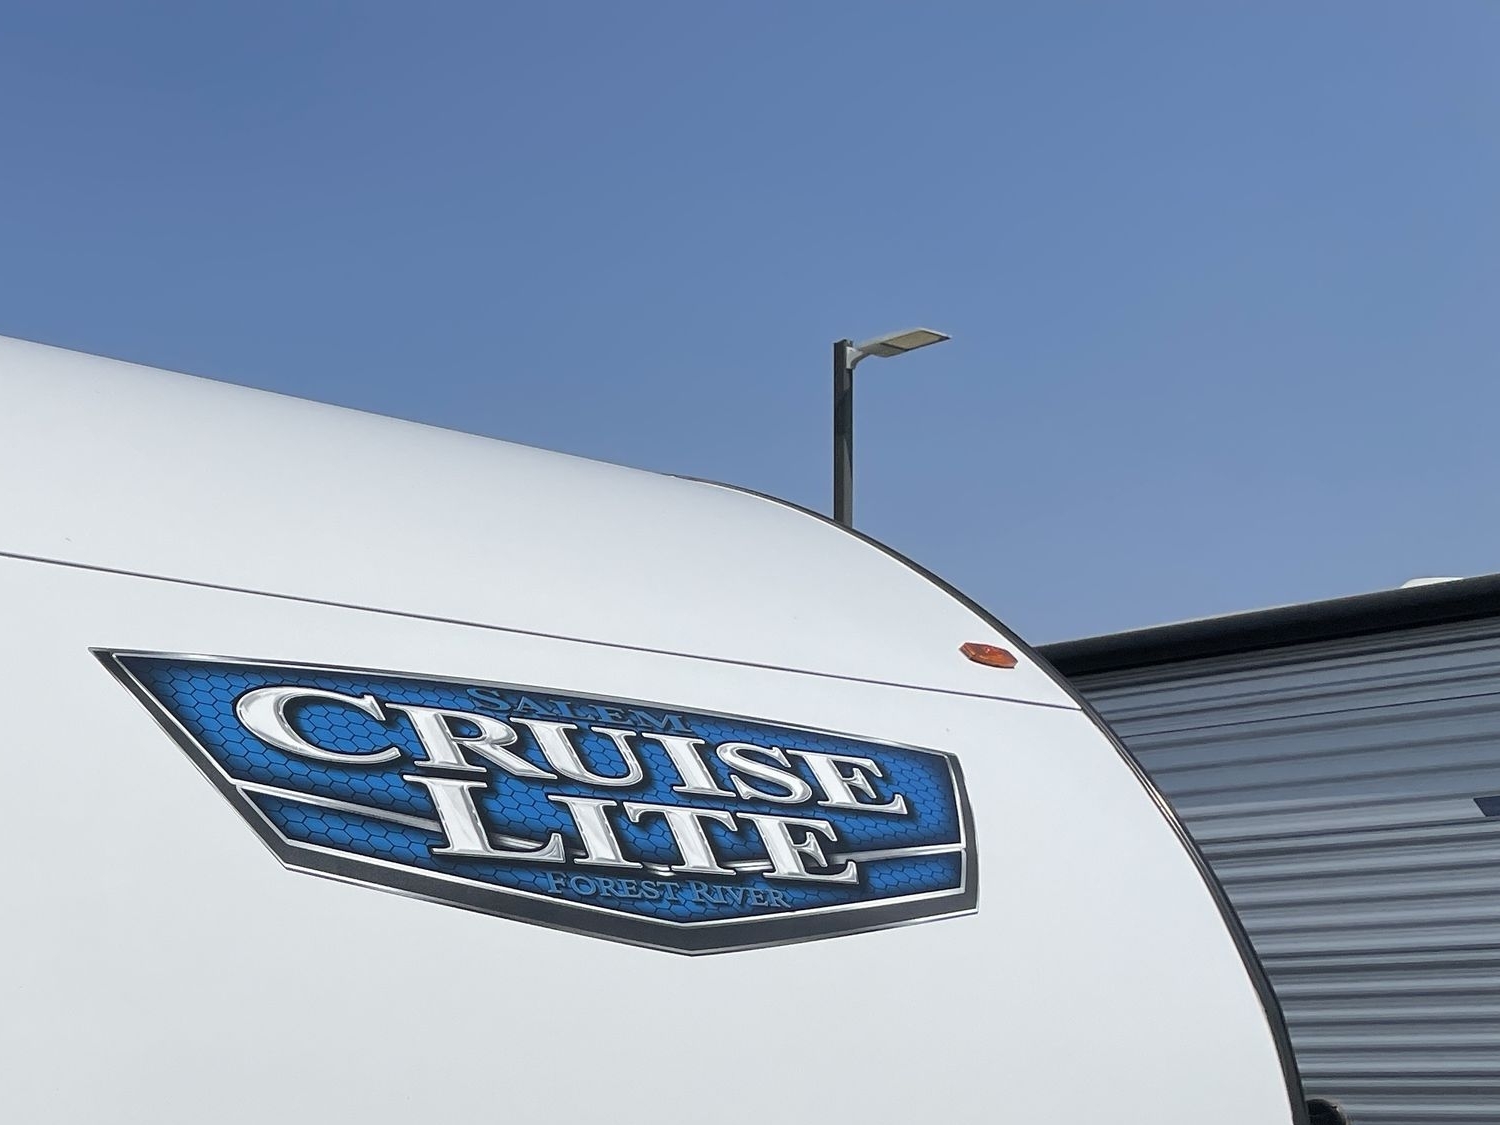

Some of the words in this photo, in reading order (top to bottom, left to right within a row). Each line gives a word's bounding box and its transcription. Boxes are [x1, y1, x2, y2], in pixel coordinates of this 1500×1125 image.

[466, 687, 696, 733] SALEM
[236, 686, 908, 815] CRUISE
[403, 774, 860, 885] LITE
[546, 871, 683, 902] FOREST
[688, 880, 791, 909] RIVER
